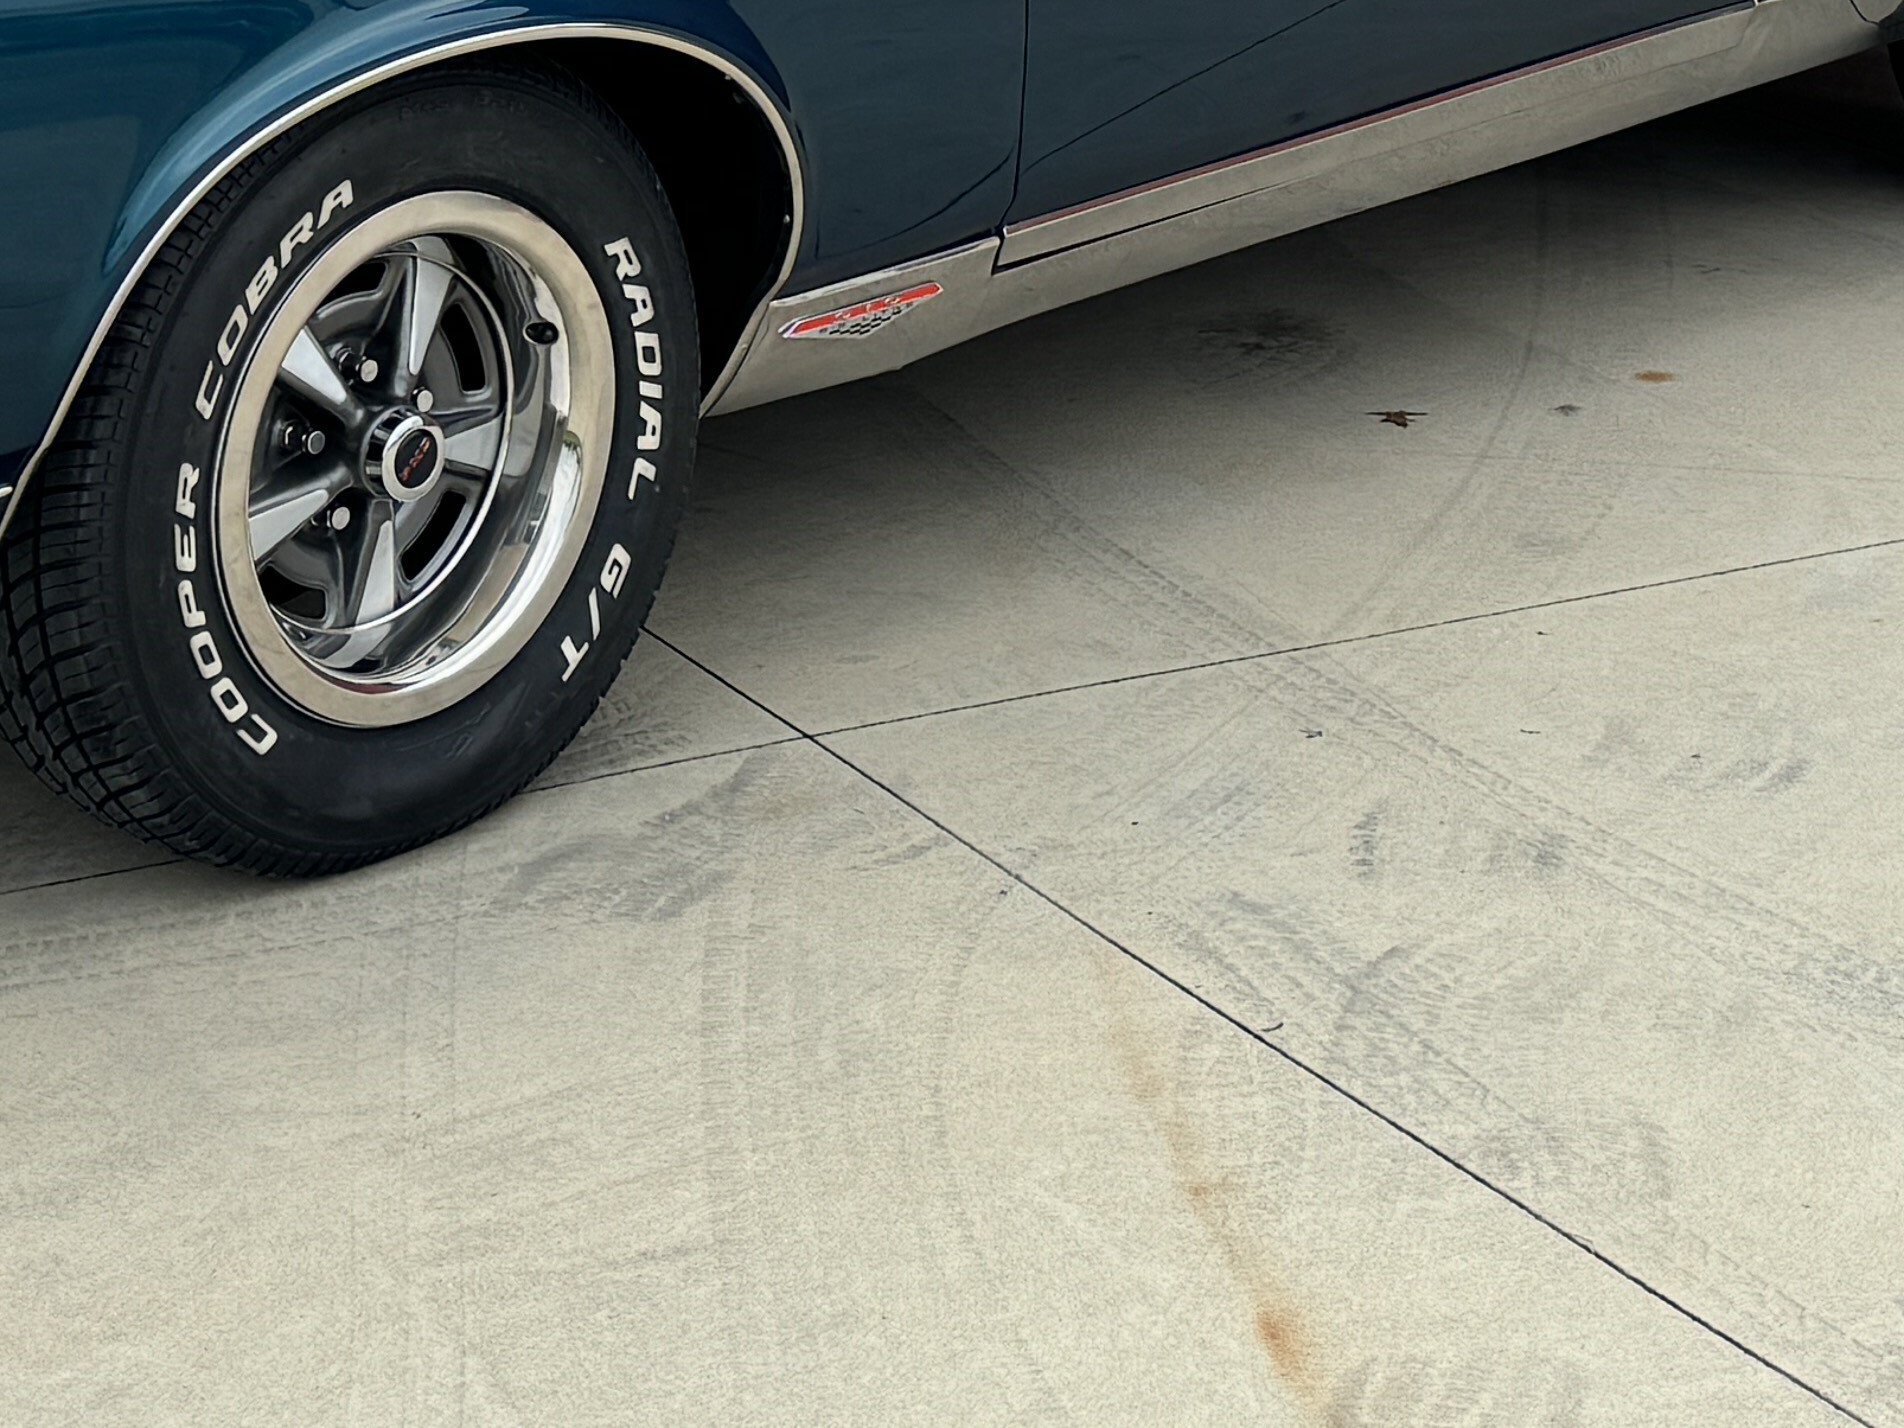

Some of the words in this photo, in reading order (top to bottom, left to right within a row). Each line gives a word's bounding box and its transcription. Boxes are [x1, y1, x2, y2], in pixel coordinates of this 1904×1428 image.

[196, 178, 355, 421] COBRA
[603, 235, 666, 501] RADIAL
[175, 461, 277, 757] COOPER
[560, 542, 631, 684] G/T
